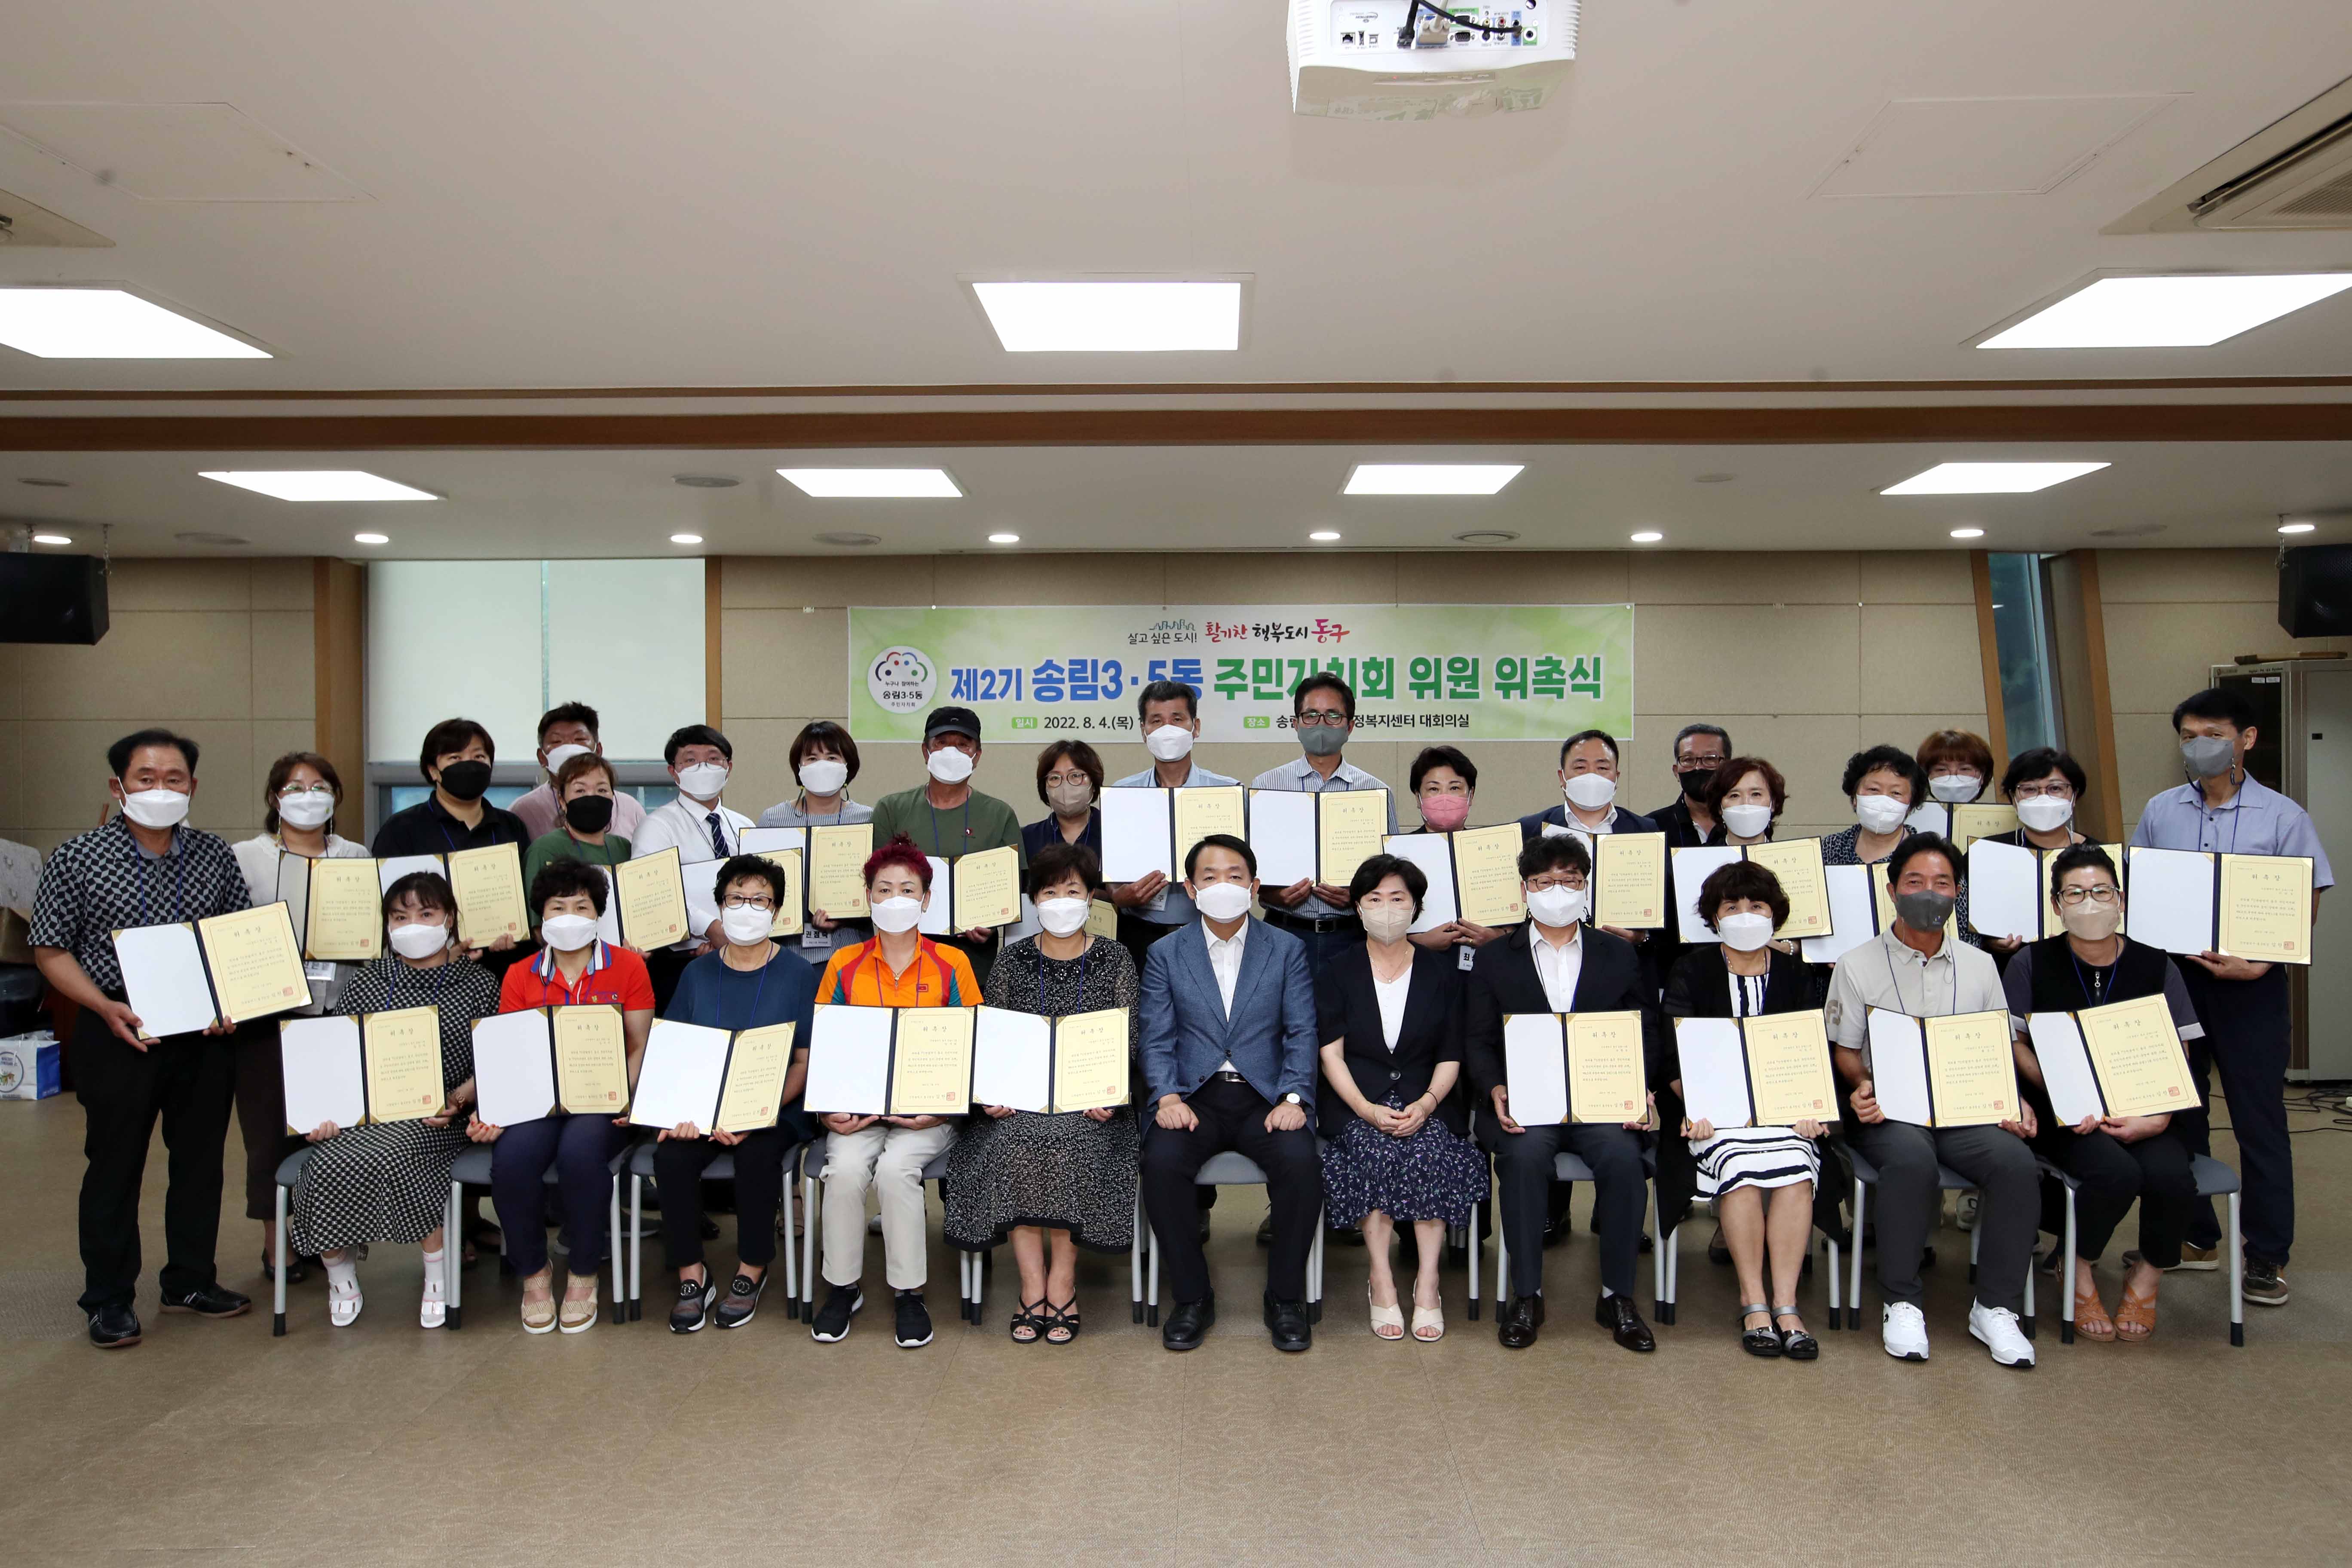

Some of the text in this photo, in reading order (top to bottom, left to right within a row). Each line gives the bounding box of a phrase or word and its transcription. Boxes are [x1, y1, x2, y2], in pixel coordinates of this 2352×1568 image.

[1127, 631, 1197, 644] 살고 싶은 도시!
[1206, 619, 1350, 643] 활기찬 행복도시 동구
[952, 668, 1022, 701] 제2기
[1409, 657, 1479, 699] 위원
[1495, 656, 1601, 699] 위촉식
[882, 691, 923, 700] 송림3·5동
[1016, 719, 1033, 728] 일시
[1044, 717, 1080, 729] 2022.
[1083, 717, 1095, 729] 8.
[1098, 716, 1134, 730] 4.(목)
[1247, 718, 1265, 728] 장소
[1354, 714, 1415, 728] 정복지센터
[1420, 714, 1470, 728] 대회의실
